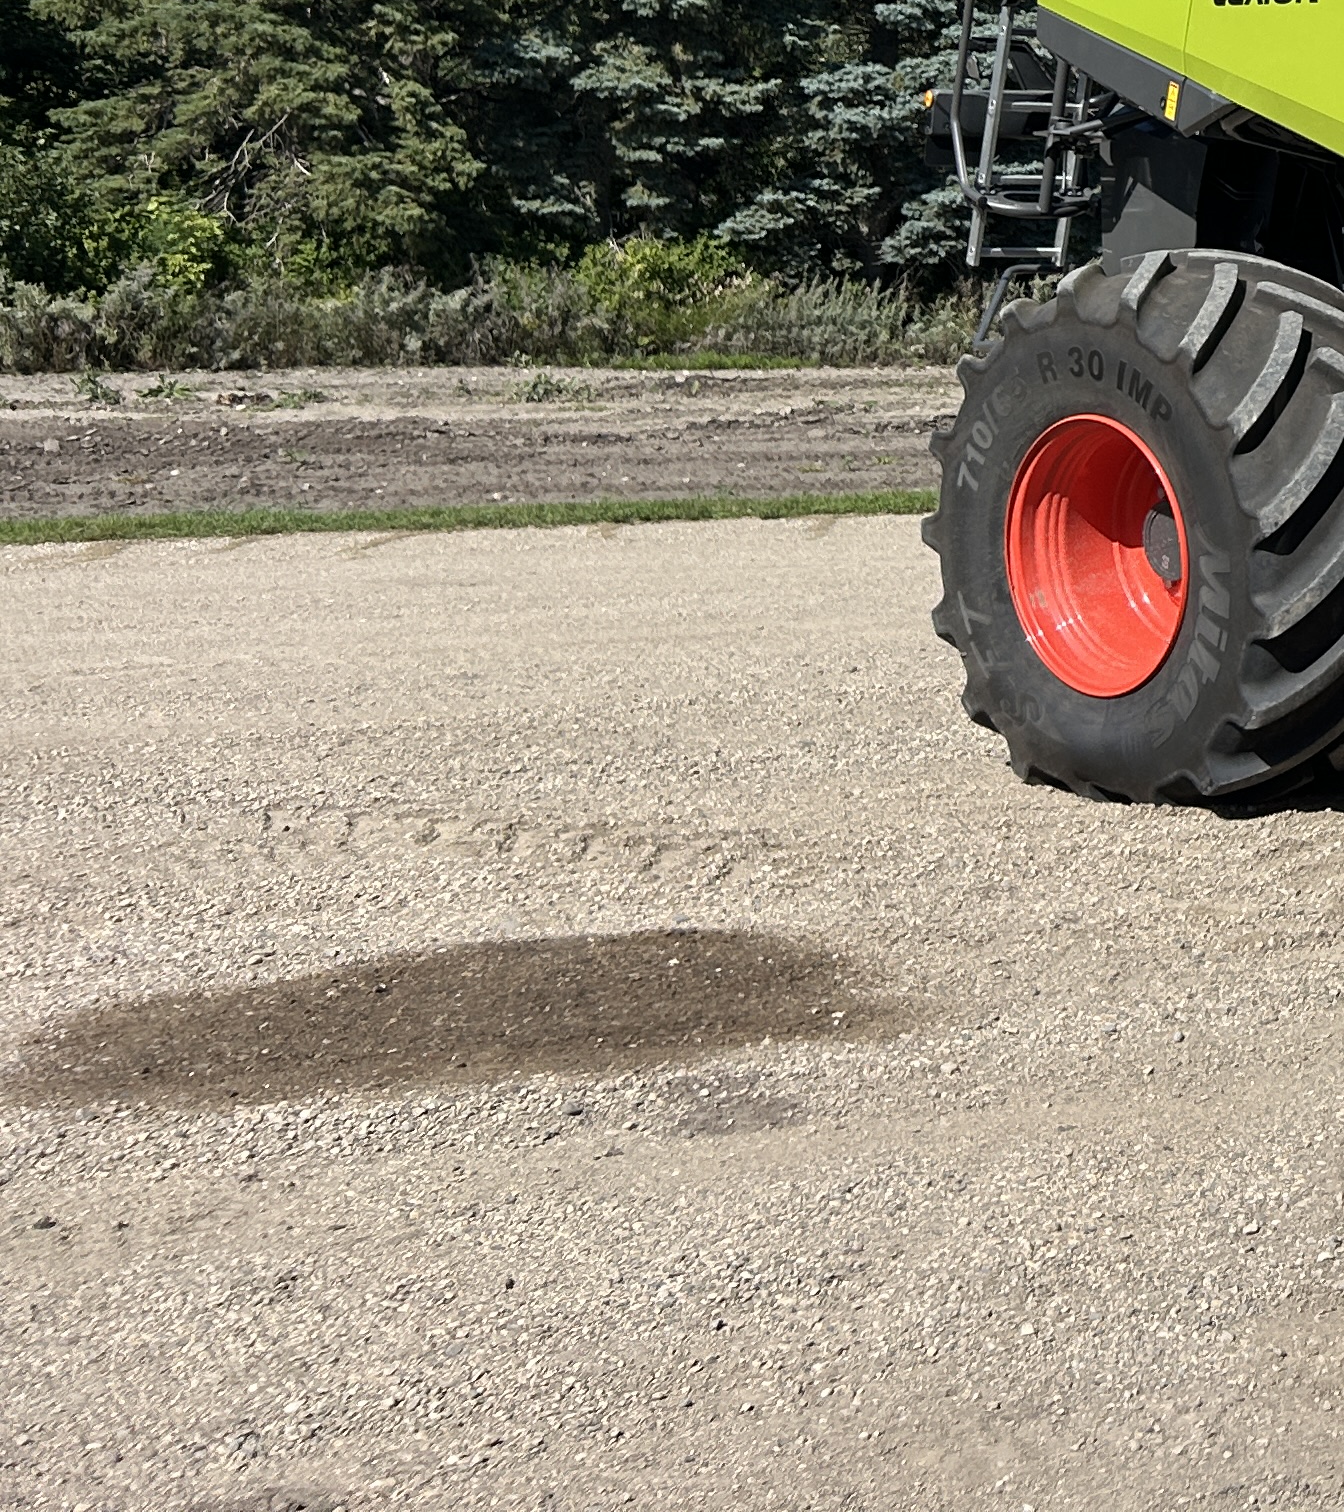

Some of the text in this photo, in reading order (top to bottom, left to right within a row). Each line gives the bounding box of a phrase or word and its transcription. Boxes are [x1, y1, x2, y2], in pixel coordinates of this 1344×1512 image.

[1036, 350, 1058, 385] R
[1066, 345, 1105, 382] 30
[1115, 359, 1173, 421] IMP
[1145, 520, 1231, 750] Mitas
